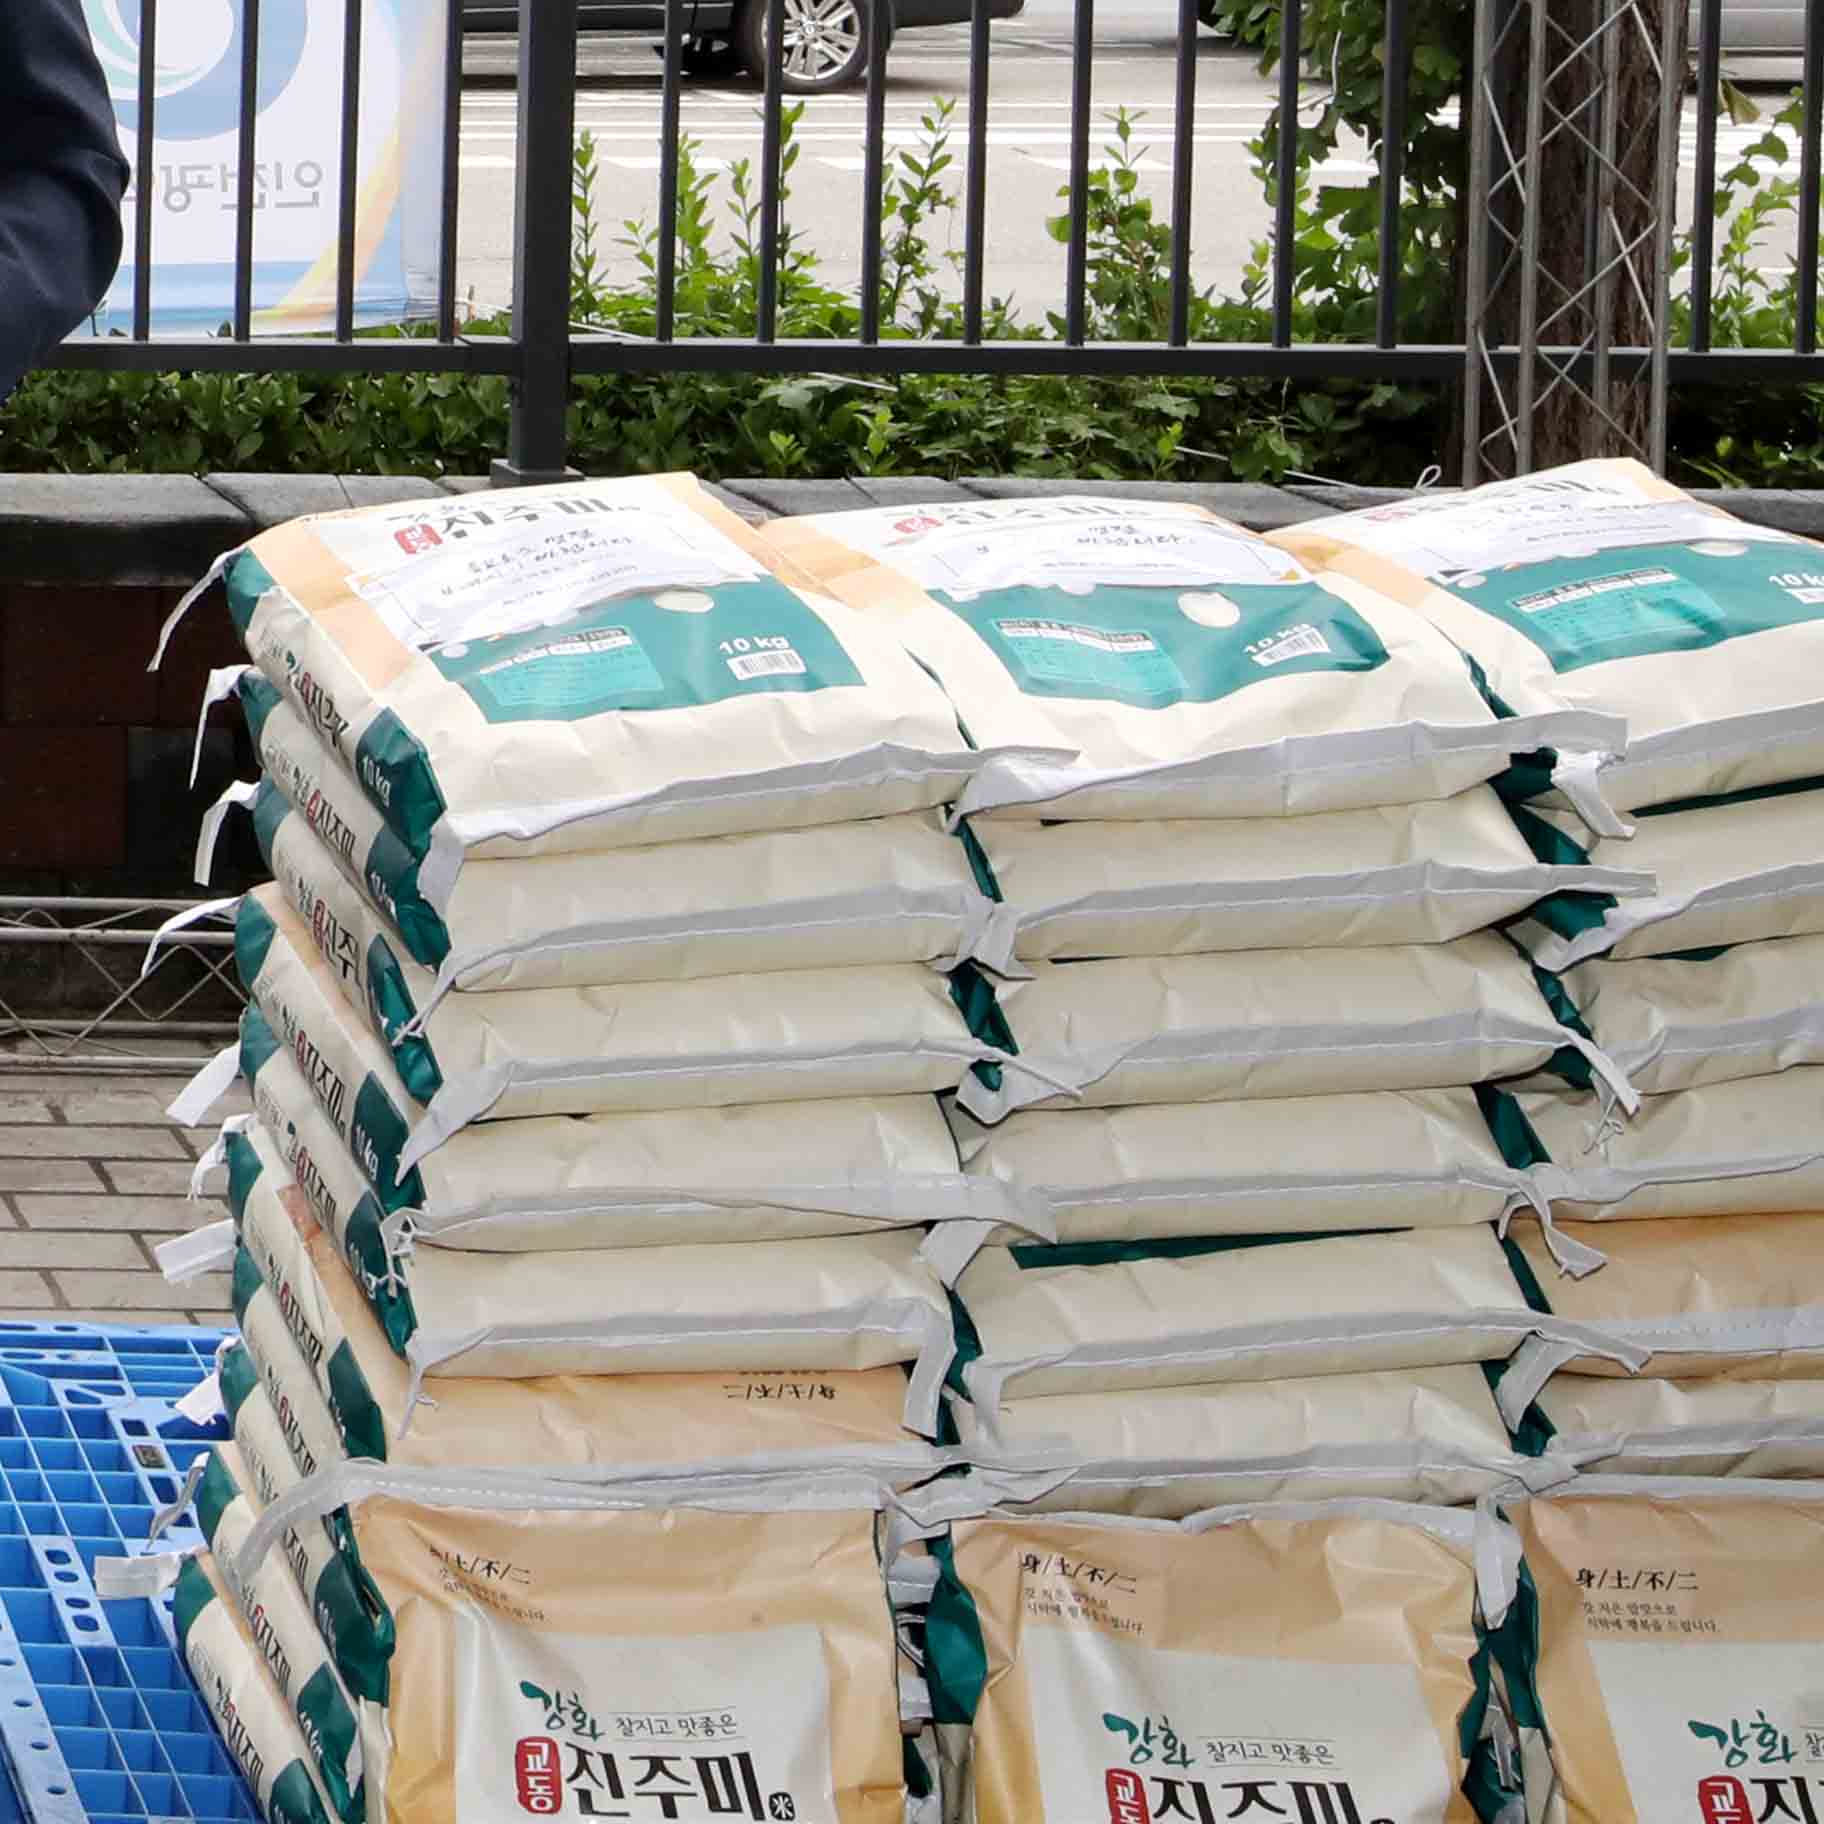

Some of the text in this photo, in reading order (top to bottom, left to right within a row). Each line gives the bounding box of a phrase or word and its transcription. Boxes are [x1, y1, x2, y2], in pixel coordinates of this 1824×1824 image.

[719, 634, 791, 655] 10 kg
[1574, 1567, 1700, 1593] 身/土/不/二
[519, 1679, 738, 1742] 강화 찰지고 맛좋은
[1102, 1711, 1338, 1770] 강화 찰지고 맛좋은
[1687, 1708, 1799, 1769] 강화
[523, 1739, 557, 1812] 교동
[563, 1741, 767, 1823] 진주미
